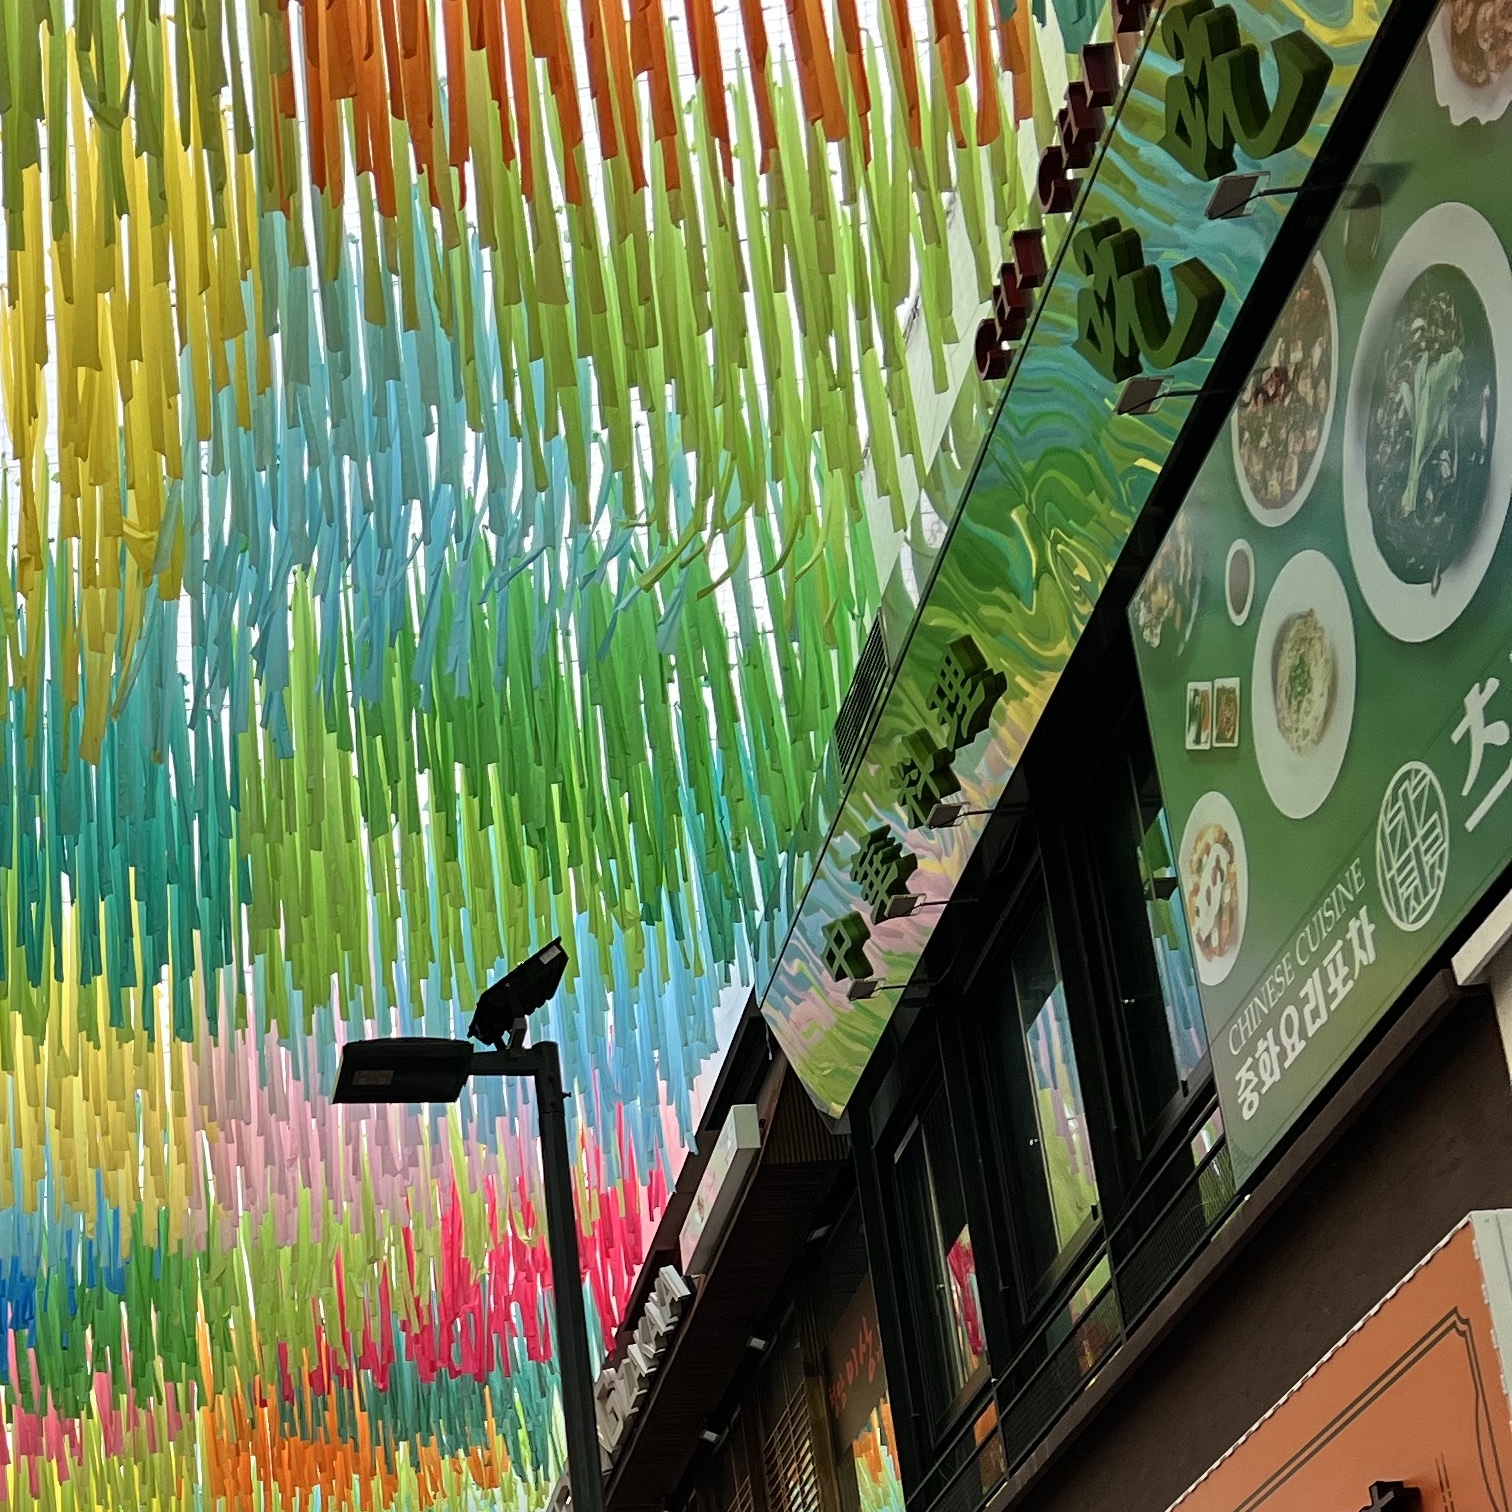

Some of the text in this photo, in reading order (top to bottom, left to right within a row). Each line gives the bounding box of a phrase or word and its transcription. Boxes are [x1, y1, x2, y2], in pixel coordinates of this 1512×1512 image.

[1228, 858, 1366, 1056] CHINESE CUISINE
[1233, 906, 1376, 1121] 중화요리포차
